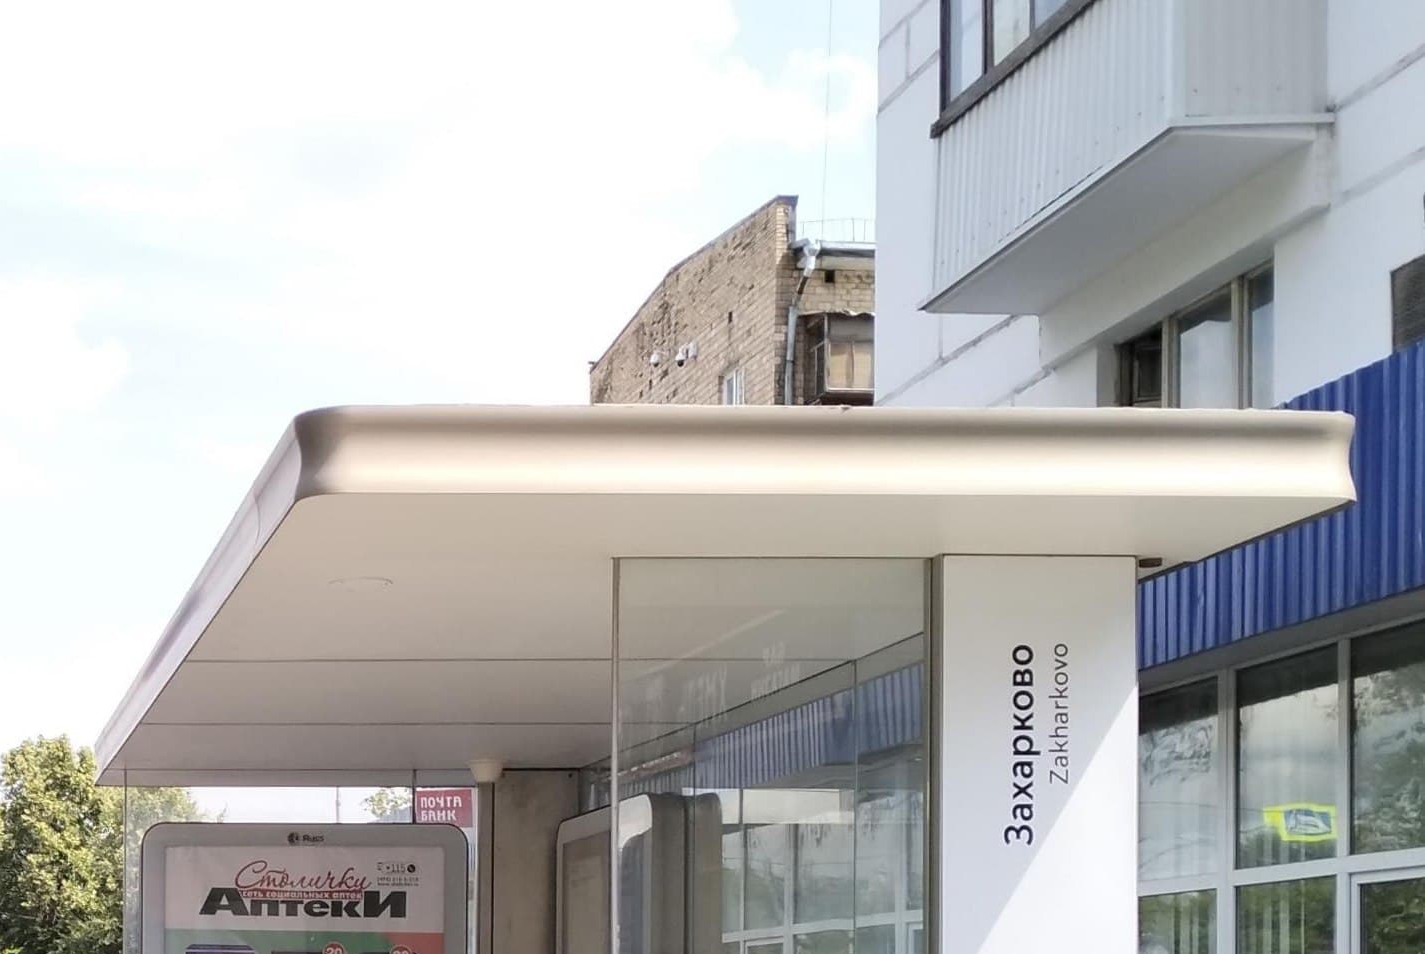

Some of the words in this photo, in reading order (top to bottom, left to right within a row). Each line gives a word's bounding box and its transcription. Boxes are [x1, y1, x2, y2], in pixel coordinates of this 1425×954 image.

[1048, 643, 1069, 784] Zakharkovo
[1003, 644, 1041, 846] Захарково
[420, 796, 463, 809] ПОЧТА
[421, 809, 457, 822] БАНК
[235, 859, 374, 891] Столички
